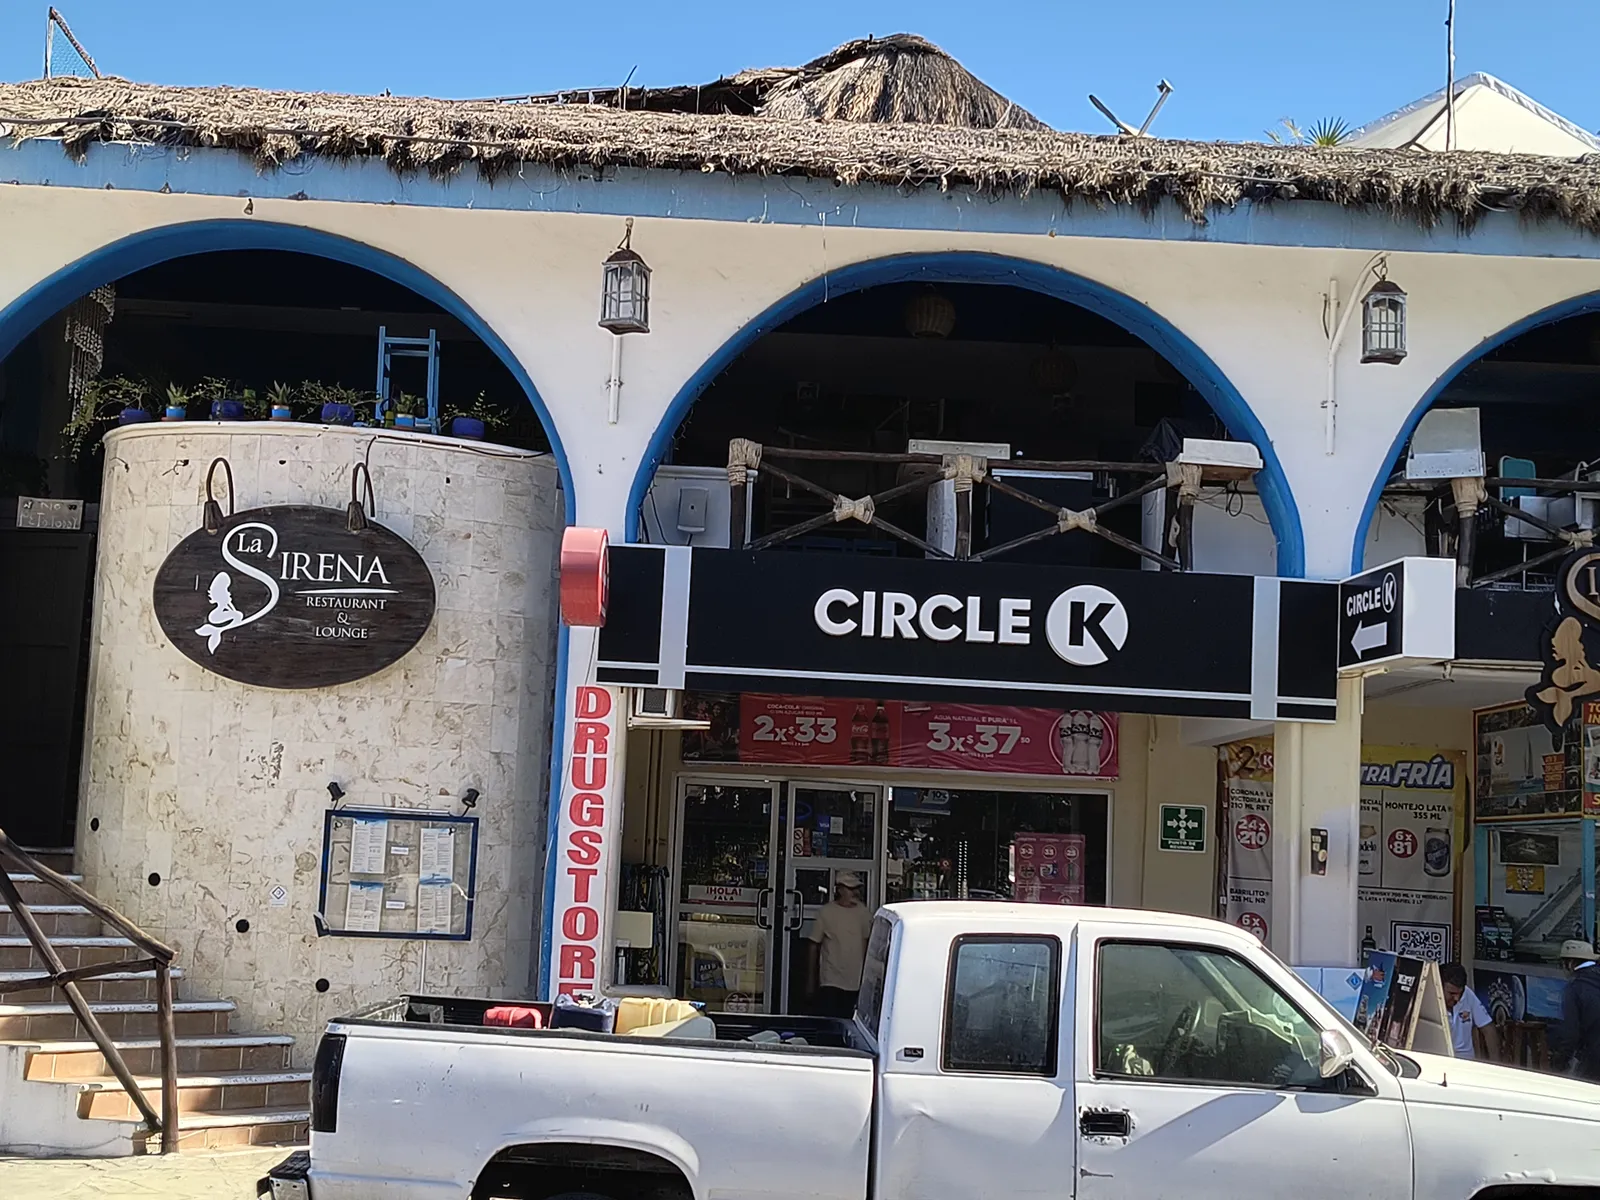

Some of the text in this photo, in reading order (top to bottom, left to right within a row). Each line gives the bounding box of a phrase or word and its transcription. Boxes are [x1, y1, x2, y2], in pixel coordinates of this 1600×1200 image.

[237, 533, 263, 554] La
[222, 521, 391, 626] SIRENA
[306, 596, 387, 610] RESTAURANT
[1346, 586, 1381, 617] CIRCLE
[337, 611, 350, 625] &
[814, 588, 1129, 662] CIRCLE K
[315, 626, 368, 639] LOUNGE
[1384, 801, 1447, 812] MONTEJO LATA
[1413, 811, 1442, 820] 355 ML
